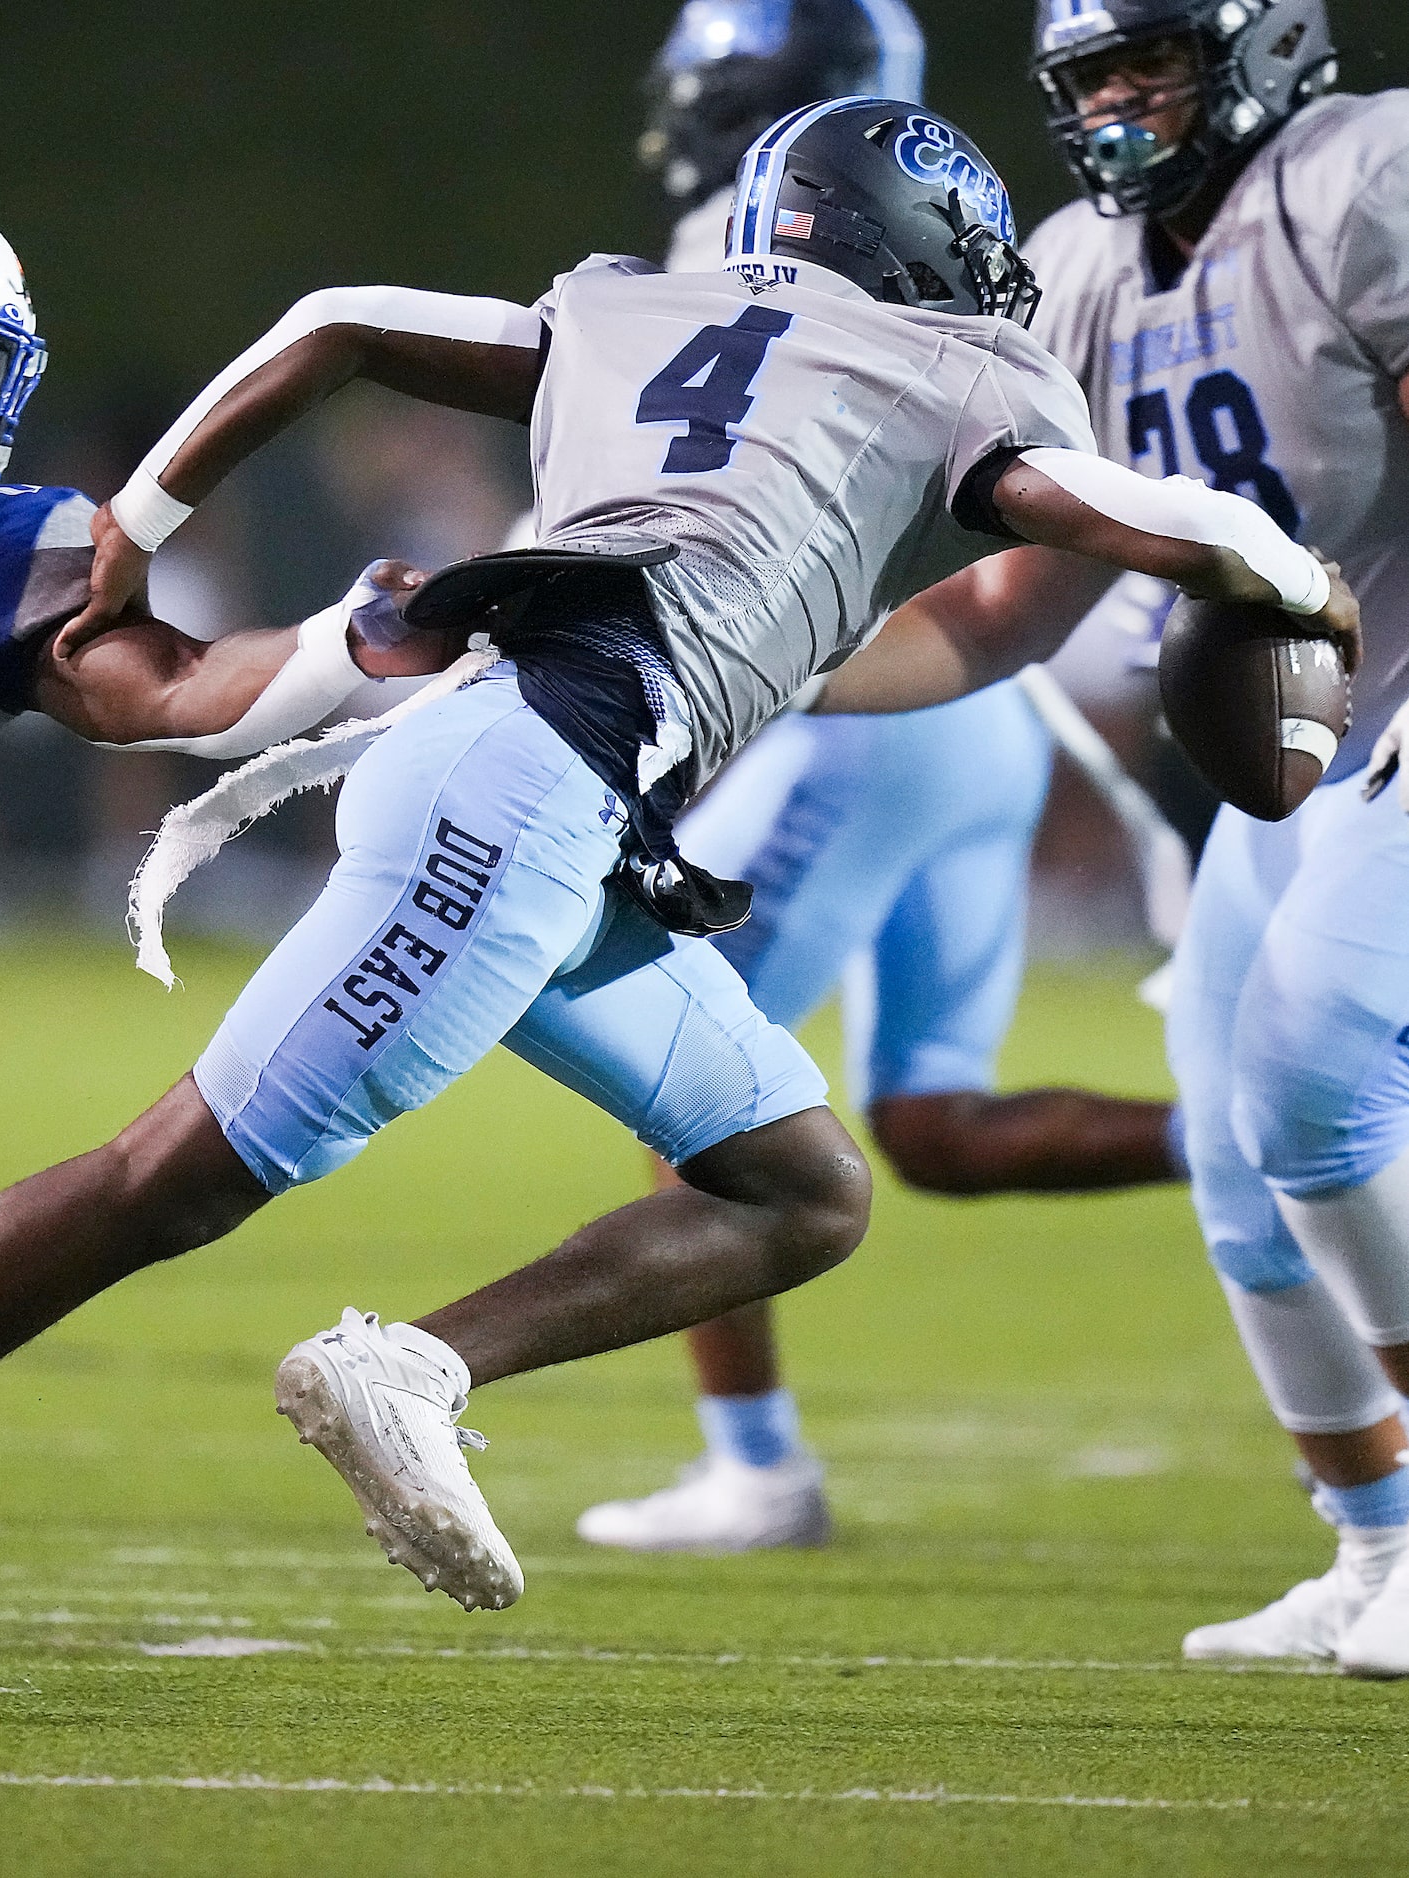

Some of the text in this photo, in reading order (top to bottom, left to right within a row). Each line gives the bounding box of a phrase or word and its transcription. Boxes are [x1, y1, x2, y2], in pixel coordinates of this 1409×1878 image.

[634, 303, 796, 474] 4
[1125, 369, 1303, 542] 78
[322, 816, 504, 1052] DUB EAST
